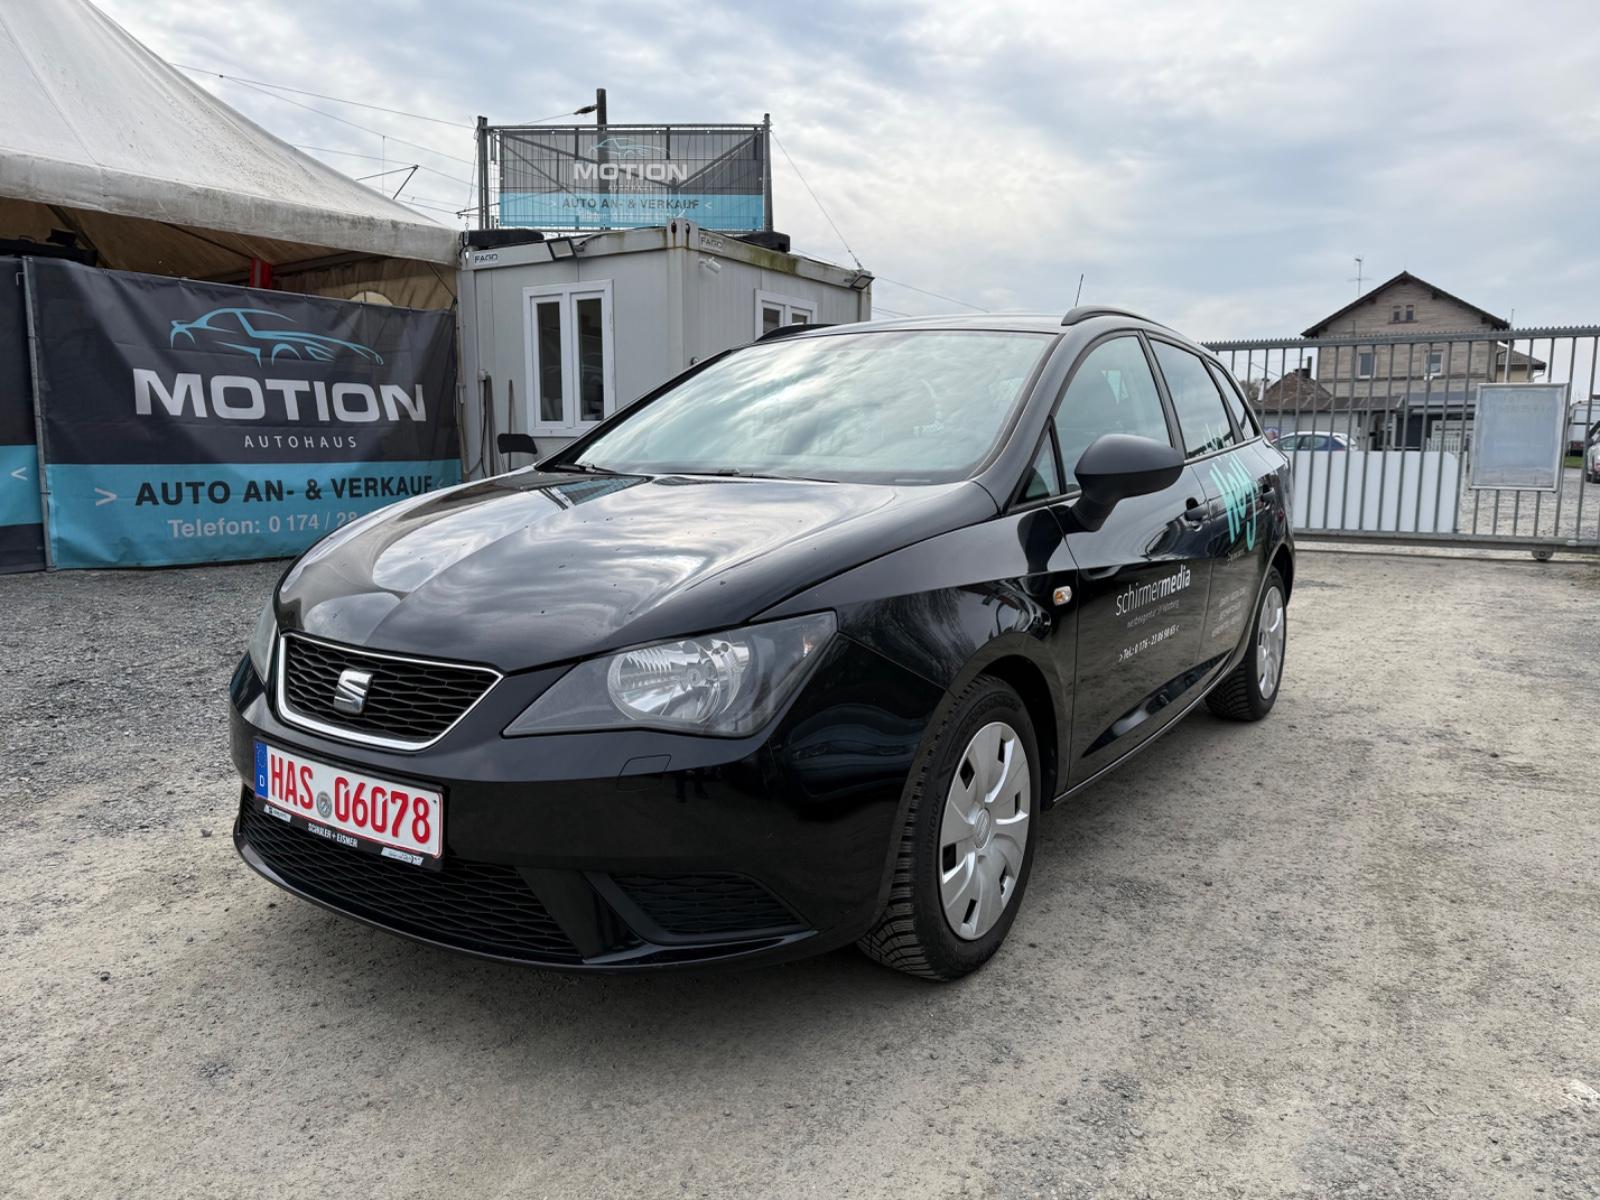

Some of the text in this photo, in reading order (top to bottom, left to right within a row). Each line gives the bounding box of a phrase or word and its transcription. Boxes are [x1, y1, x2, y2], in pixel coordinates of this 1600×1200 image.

[573, 163, 689, 181] MOTION
[562, 199, 597, 209] AUTO
[627, 199, 638, 209] &
[640, 198, 699, 209] VERKAUF
[132, 368, 427, 423] MOTION
[244, 435, 357, 448] AUTOHAUS
[135, 475, 433, 506] AUTO AN- & VERKAUF
[168, 517, 260, 538] Telefon:
[269, 516, 281, 533] 0
[286, 511, 319, 531] 174
[1115, 563, 1191, 616] schirmermedia
[259, 774, 265, 787] D
[270, 754, 314, 810] HAS
[334, 776, 431, 844] 06078
